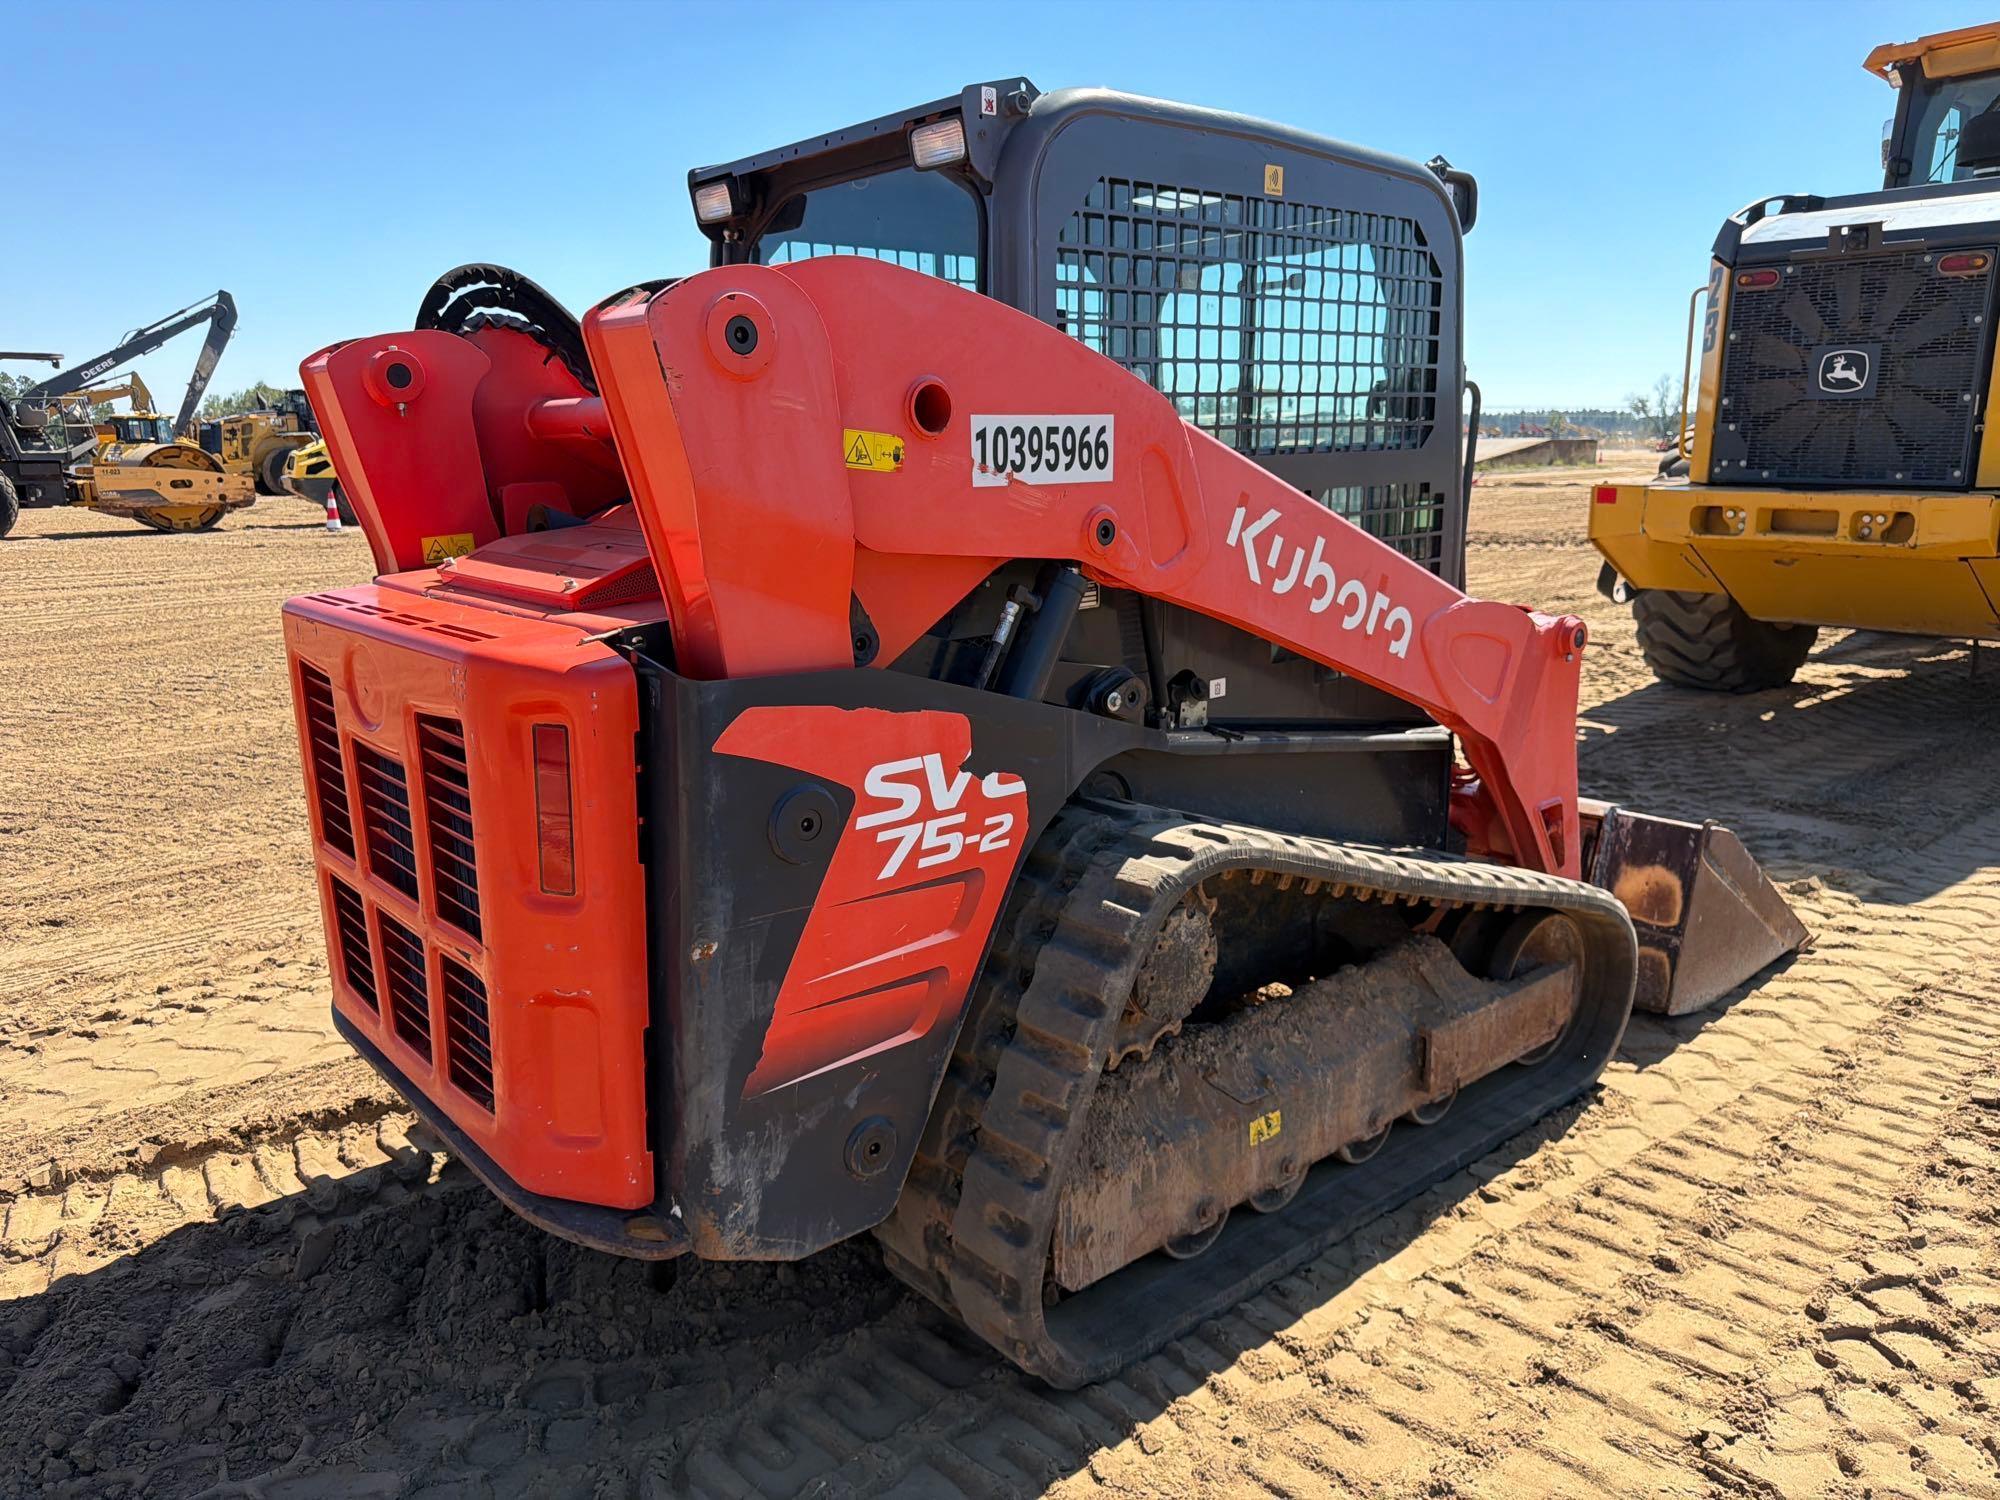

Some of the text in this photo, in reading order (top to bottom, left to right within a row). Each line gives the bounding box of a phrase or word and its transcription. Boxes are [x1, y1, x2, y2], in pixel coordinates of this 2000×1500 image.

[81, 357, 116, 380] DEERE
[975, 425, 1109, 474] 10395966
[1226, 507, 1413, 660] Kubota
[876, 812, 1014, 881] 75-2
